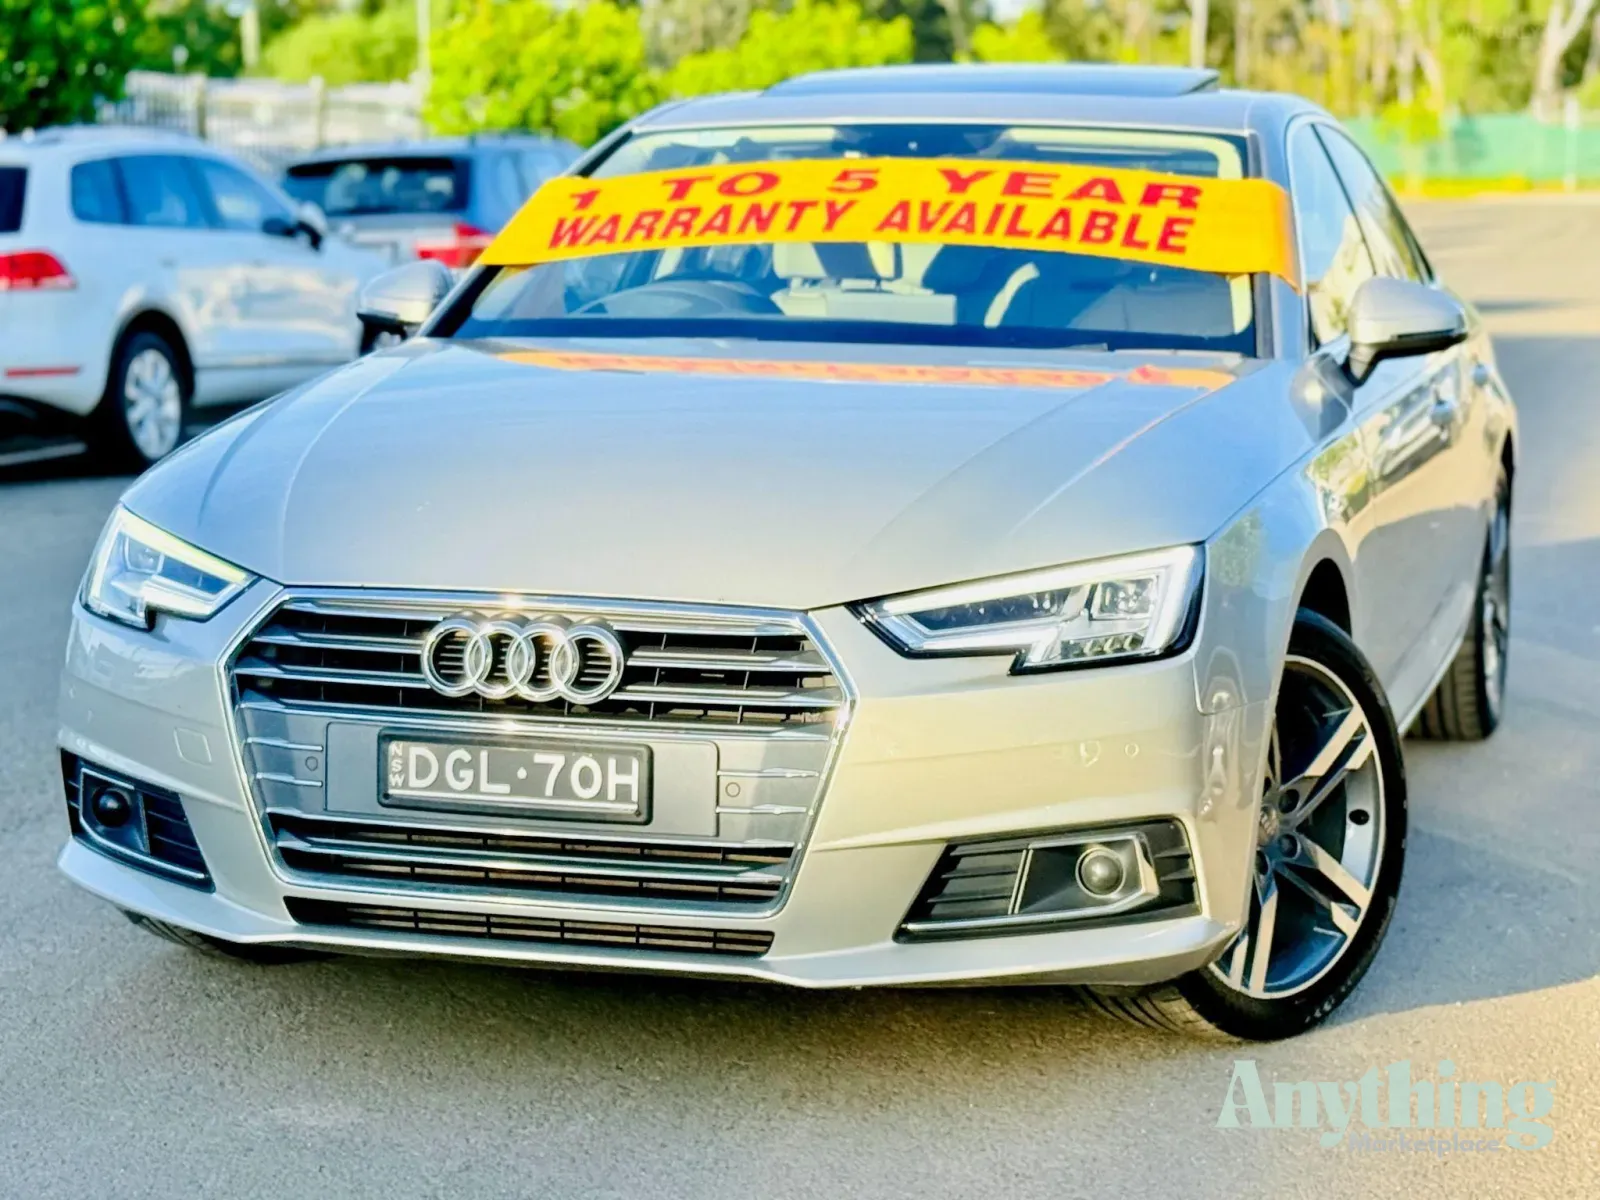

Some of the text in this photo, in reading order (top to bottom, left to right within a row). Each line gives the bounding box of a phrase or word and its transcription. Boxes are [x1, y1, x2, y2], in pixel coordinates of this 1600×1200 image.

[569, 168, 1202, 211] 1 TO 5 YEAR
[547, 199, 1196, 253] WARRANTY AVAILABLE
